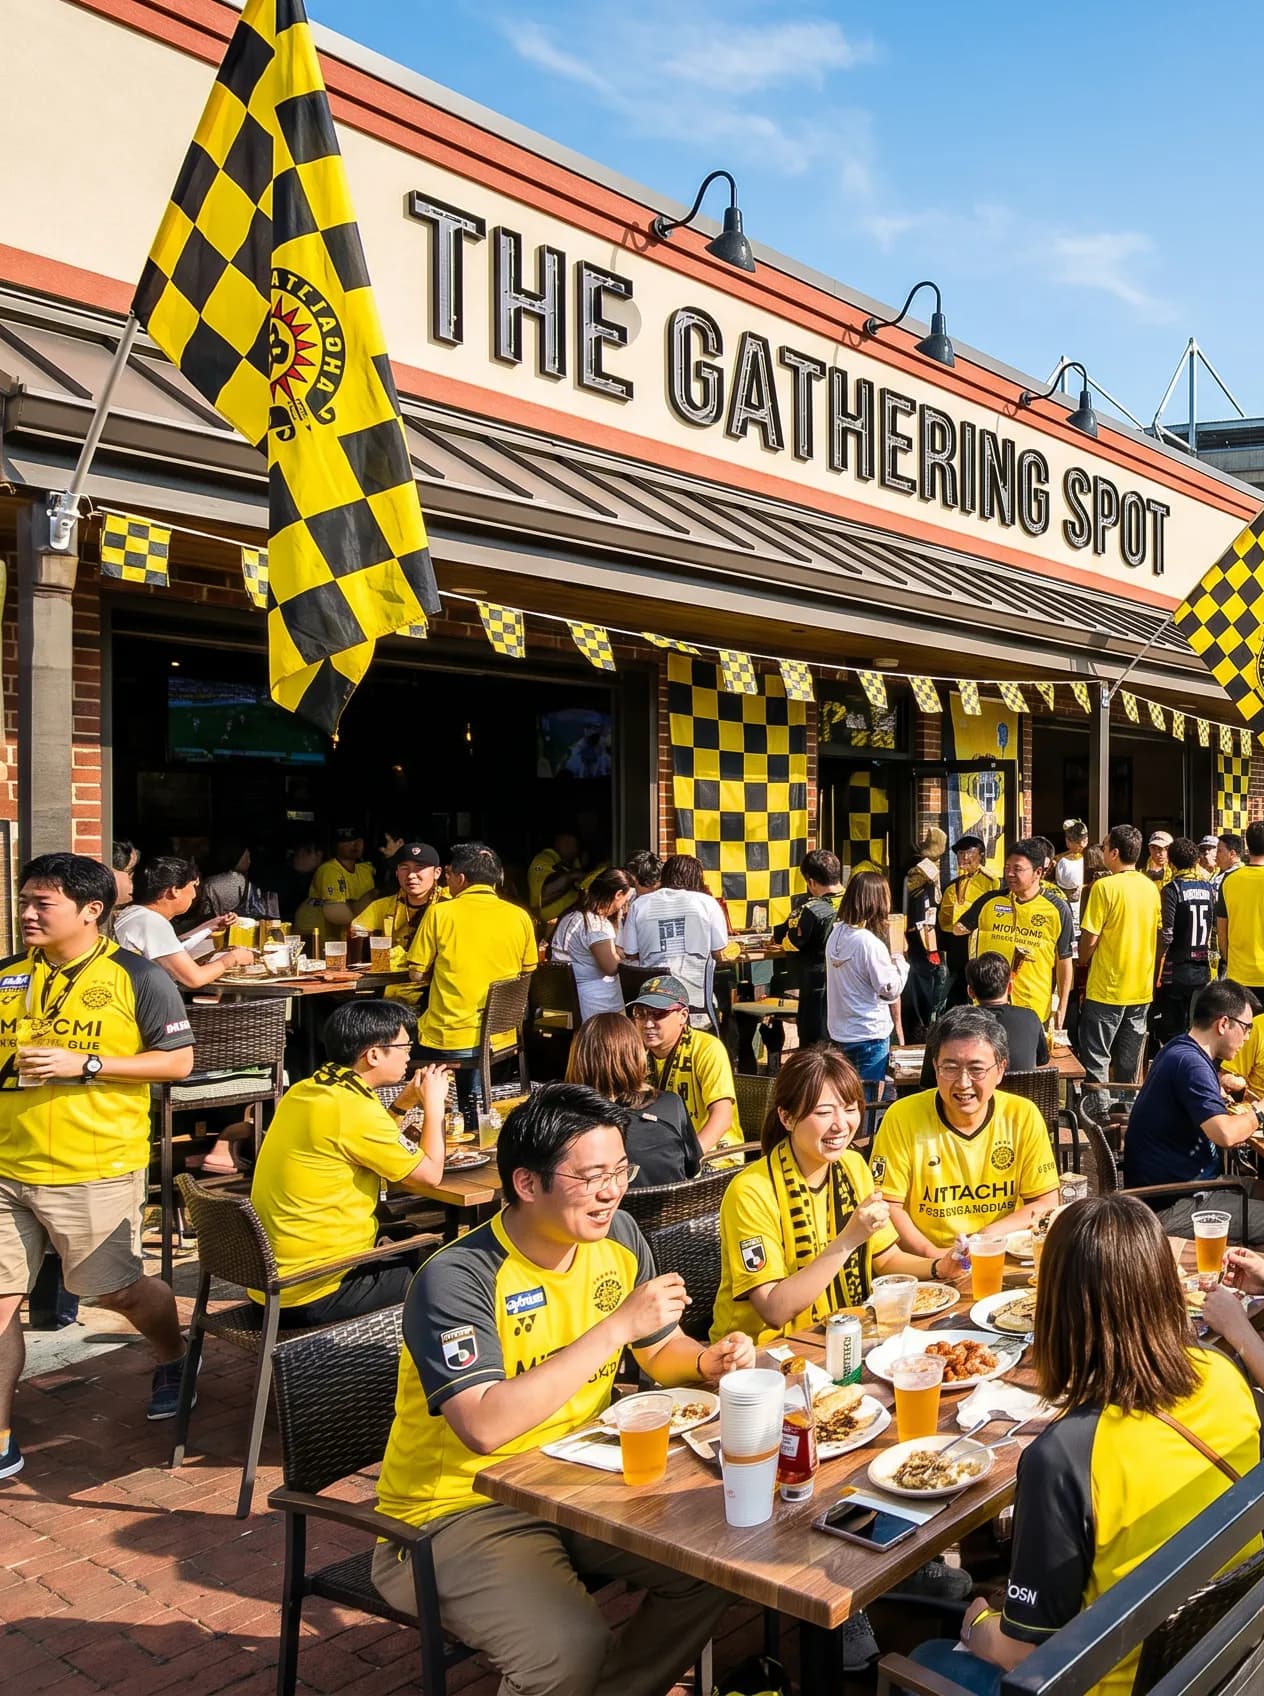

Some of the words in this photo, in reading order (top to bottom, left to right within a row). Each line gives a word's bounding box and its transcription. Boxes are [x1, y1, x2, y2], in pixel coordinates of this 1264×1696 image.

[405, 190, 633, 402] THE
[668, 306, 1049, 536] GATHERING
[1063, 467, 1170, 575] SPOT
[1190, 905, 1208, 947] 15
